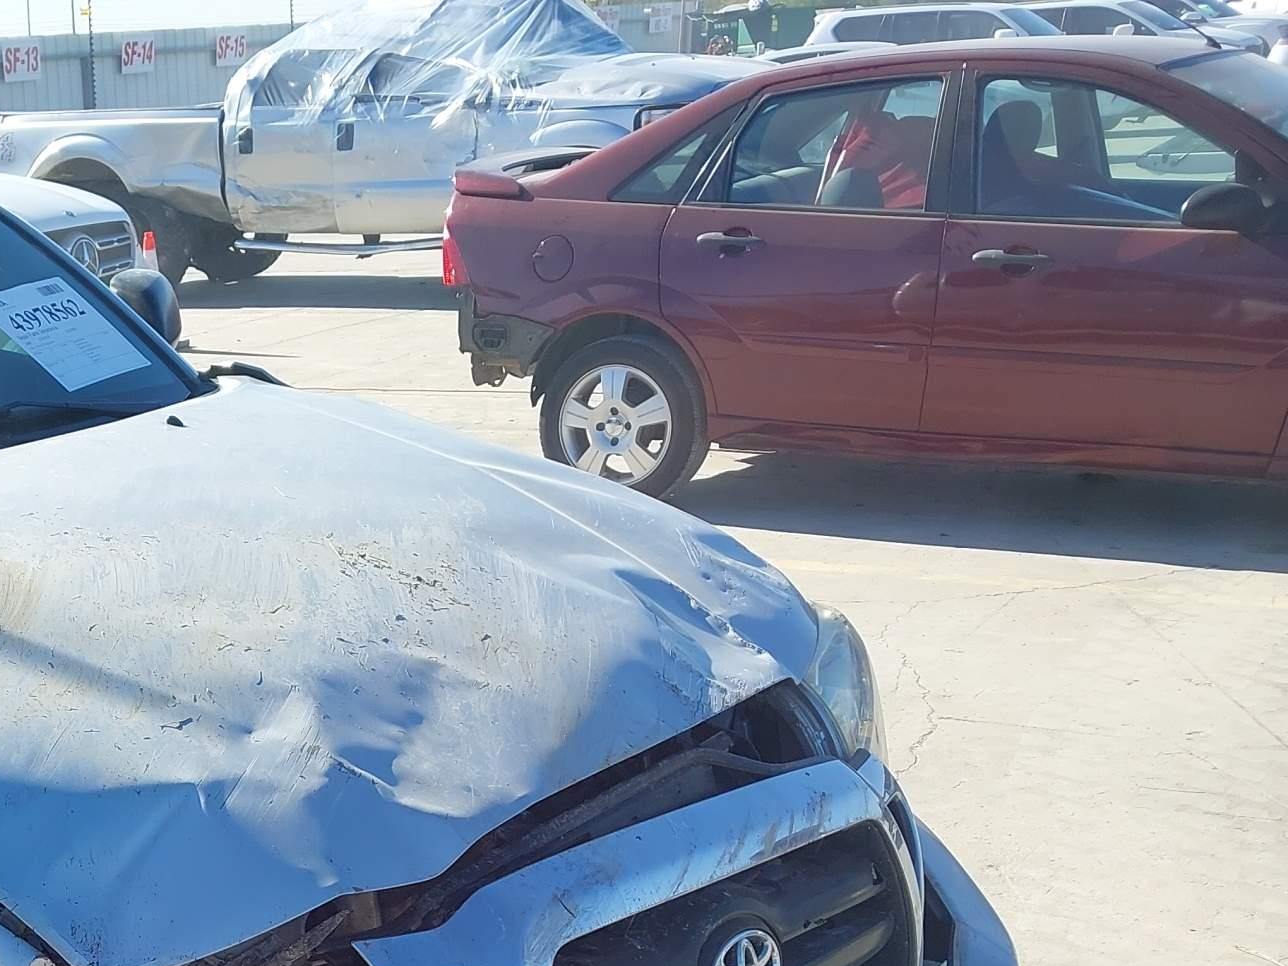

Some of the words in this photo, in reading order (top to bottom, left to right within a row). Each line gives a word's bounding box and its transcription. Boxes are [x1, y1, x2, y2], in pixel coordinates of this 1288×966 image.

[4, 46, 39, 74] SF-13
[123, 40, 154, 66] SF-14
[217, 35, 245, 60] SF-15
[8, 299, 87, 332] 43978562
